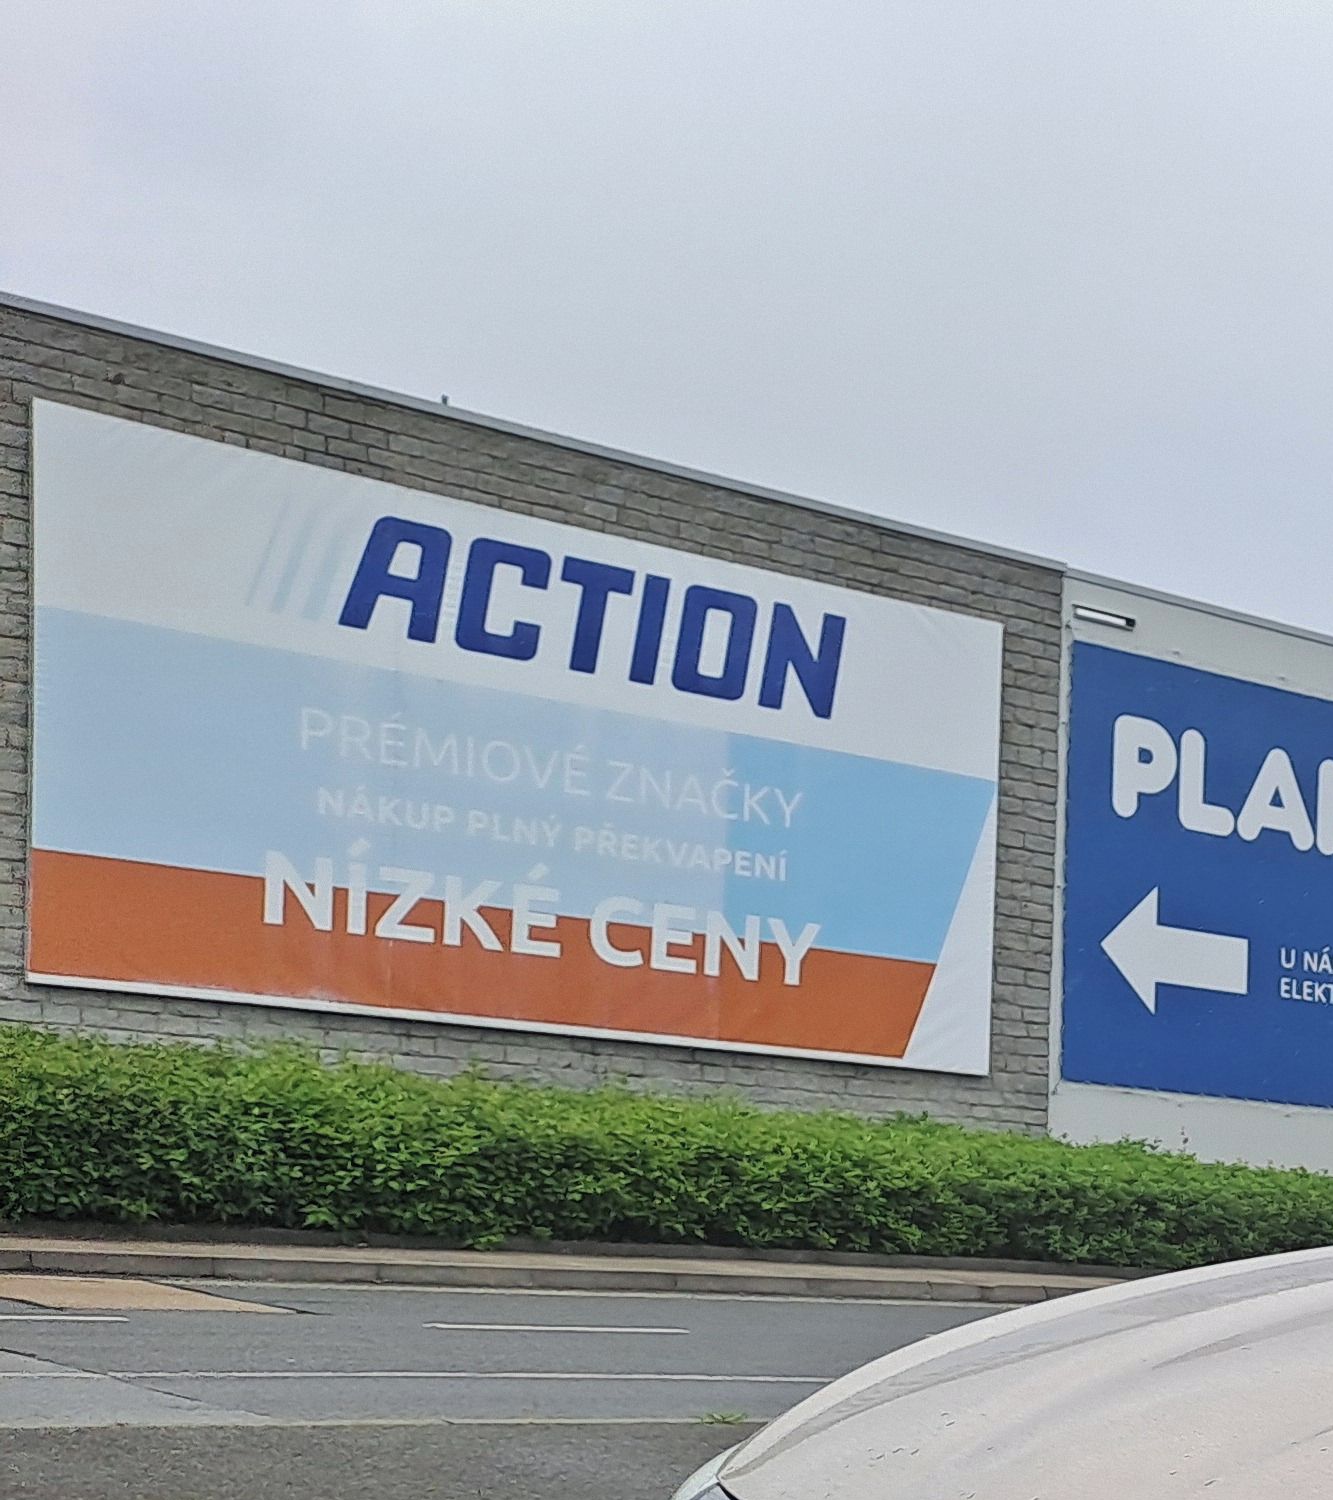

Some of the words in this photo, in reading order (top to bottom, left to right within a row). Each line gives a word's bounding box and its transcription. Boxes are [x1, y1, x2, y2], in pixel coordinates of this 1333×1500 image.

[338, 515, 847, 719] ACTION
[300, 706, 591, 797] PRÉMIOVÉ
[606, 761, 804, 829] ZNAČKY
[316, 785, 456, 833] NÁKUP
[467, 810, 562, 848] PLNÝ
[573, 824, 789, 882] PŘEKVAPENÍ
[261, 837, 562, 959] NÍZKÉ
[588, 897, 822, 987] CENY
[1280, 947, 1296, 969] U
